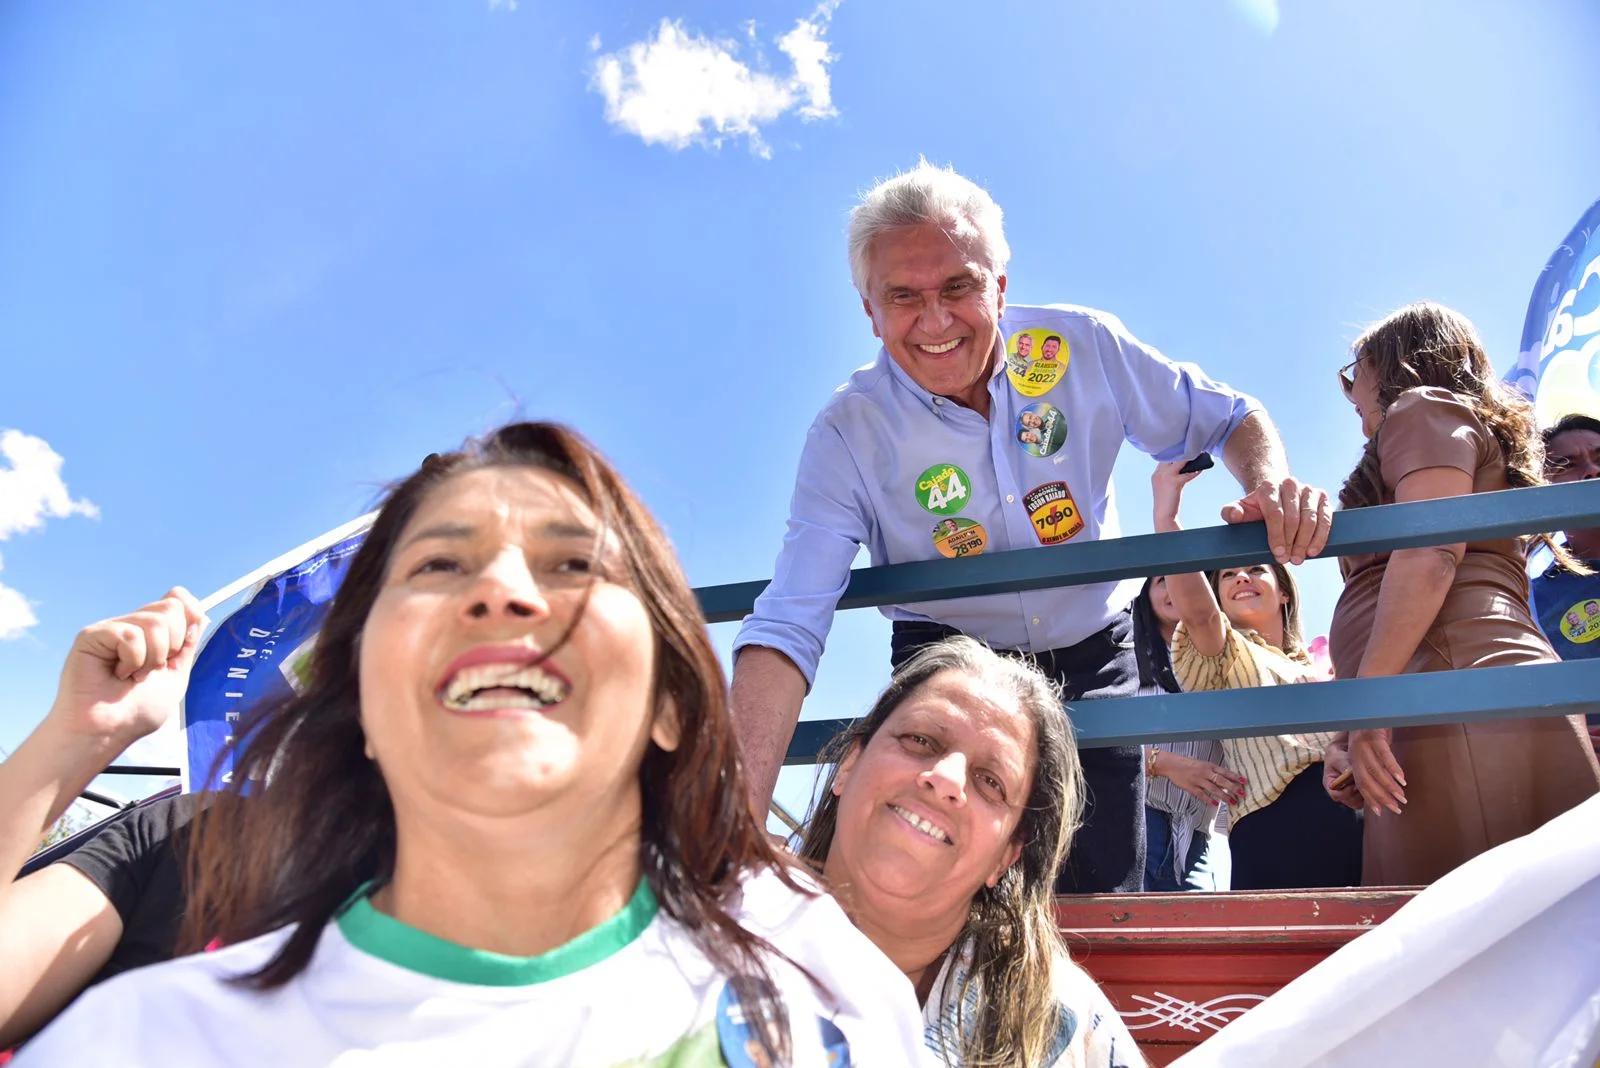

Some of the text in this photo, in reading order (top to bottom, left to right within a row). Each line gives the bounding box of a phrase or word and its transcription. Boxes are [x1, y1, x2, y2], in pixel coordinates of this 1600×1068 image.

[1028, 373, 1056, 383] 2022
[1047, 409, 1058, 424] 44
[919, 467, 955, 491] Caiado
[928, 472, 967, 510] 44
[1035, 506, 1073, 530] 7090
[948, 529, 976, 544] ADAILTN
[952, 538, 983, 558] 28190
[259, 626, 287, 661] VICE:
